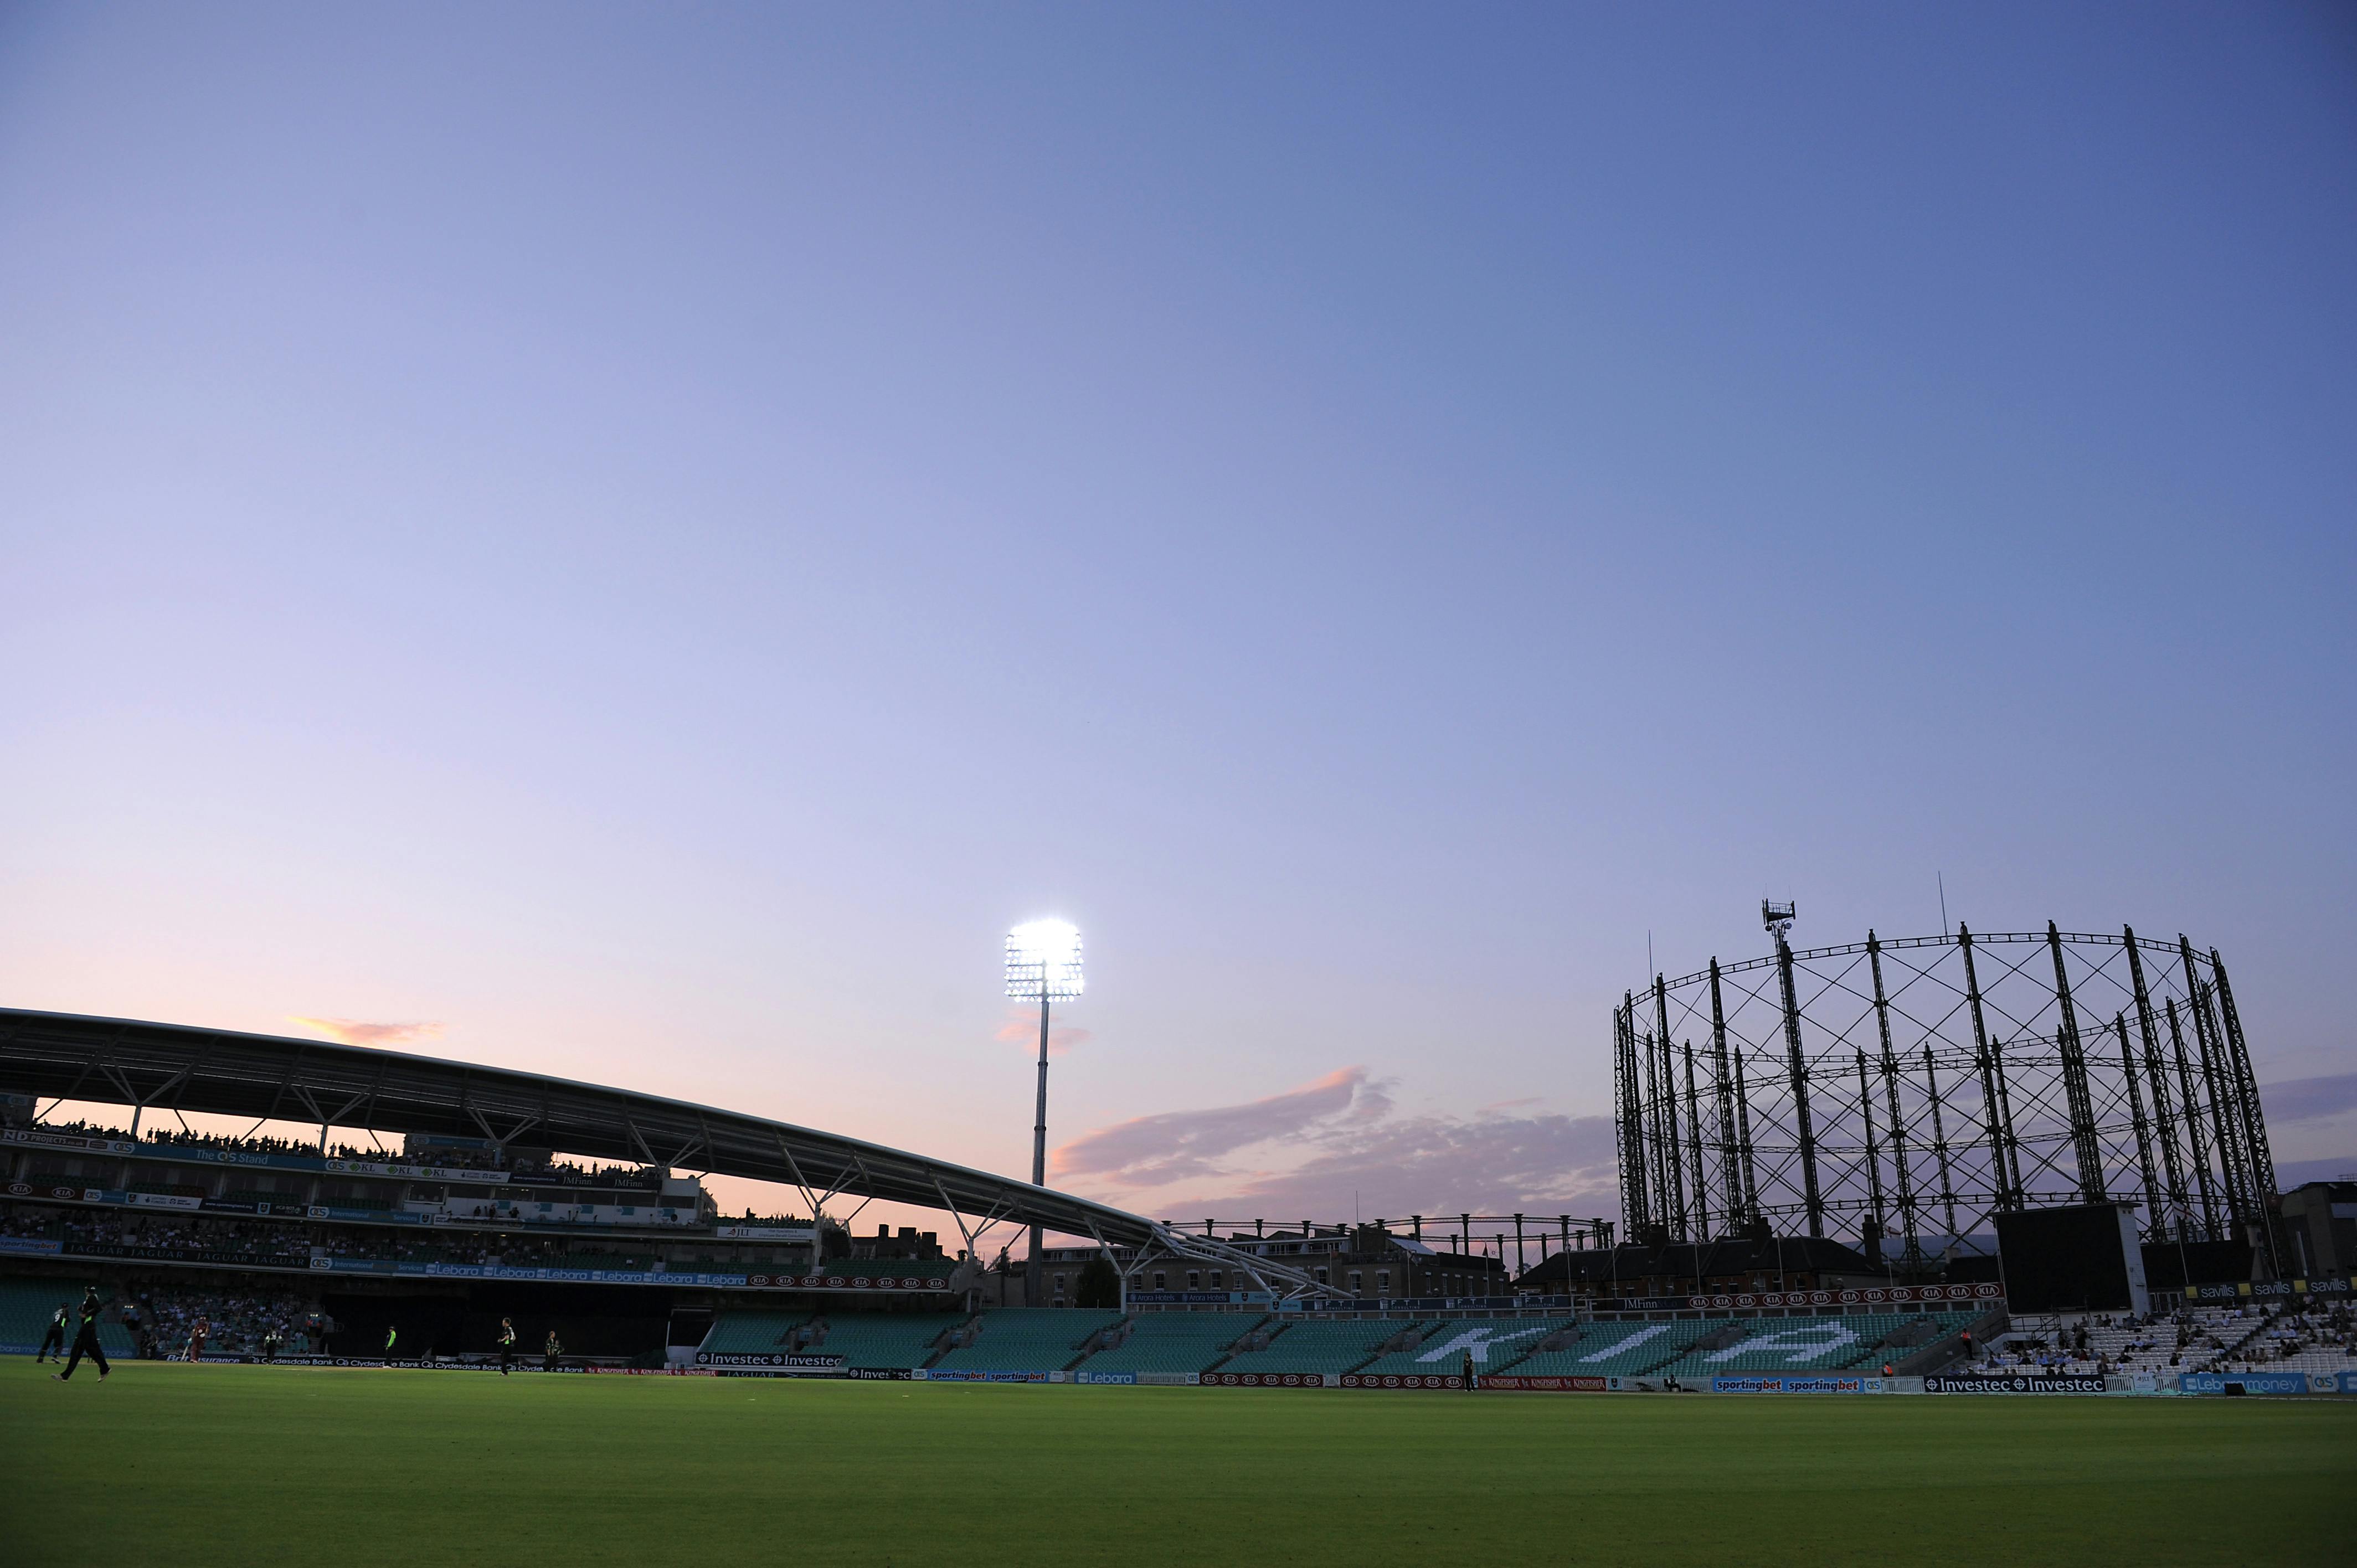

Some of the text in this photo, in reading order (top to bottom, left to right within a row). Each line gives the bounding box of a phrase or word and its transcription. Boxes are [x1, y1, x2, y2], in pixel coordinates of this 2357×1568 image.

[197, 1150, 214, 1160] The
[239, 1152, 269, 1164] Stand
[0, 1240, 58, 1250] sportingbet
[70, 1245, 125, 1255] JAGUAR
[131, 1249, 183, 1259] JAGUAR
[196, 1252, 249, 1262] JAGUAR
[255, 1256, 305, 1266] JAGUAR
[437, 1266, 478, 1276] Lebara
[493, 1267, 535, 1278] Lebara
[547, 1269, 588, 1280] Lebara
[602, 1271, 642, 1282] Lebara
[653, 1273, 693, 1283] Lebara
[707, 1275, 747, 1285] Lebara
[2255, 1281, 2290, 1295] savills
[2310, 1277, 2347, 1292] savills
[1867, 1291, 1883, 1300] KIA
[1892, 1290, 1909, 1299] KIA
[1923, 1288, 1940, 1297] KIA
[1950, 1287, 1968, 1296] KIA
[1978, 1286, 1996, 1295] KIA
[2201, 1285, 2235, 1298] savills
[1715, 1297, 1730, 1306] KIA
[1766, 1296, 1780, 1304] KIA
[1814, 1293, 1829, 1302] KIA
[1842, 1292, 1857, 1301] KIA
[710, 1353, 769, 1364] Investec
[435, 1362, 481, 1370] Clydesdale
[931, 1371, 986, 1380] sportingbet
[990, 1372, 1045, 1381] sportingbet
[1089, 1372, 1132, 1383] Lebara
[1489, 1377, 1520, 1387] KINGFISHER
[1531, 1378, 1562, 1388] KINGFISHER
[1573, 1378, 1605, 1388] KINGFISHER
[1717, 1379, 1782, 1391] sportingbet
[1789, 1380, 1858, 1392] sportingbet
[1939, 1378, 2010, 1391] Investec
[2027, 1377, 2104, 1391] Investec
[2247, 1380, 2298, 1392] money
